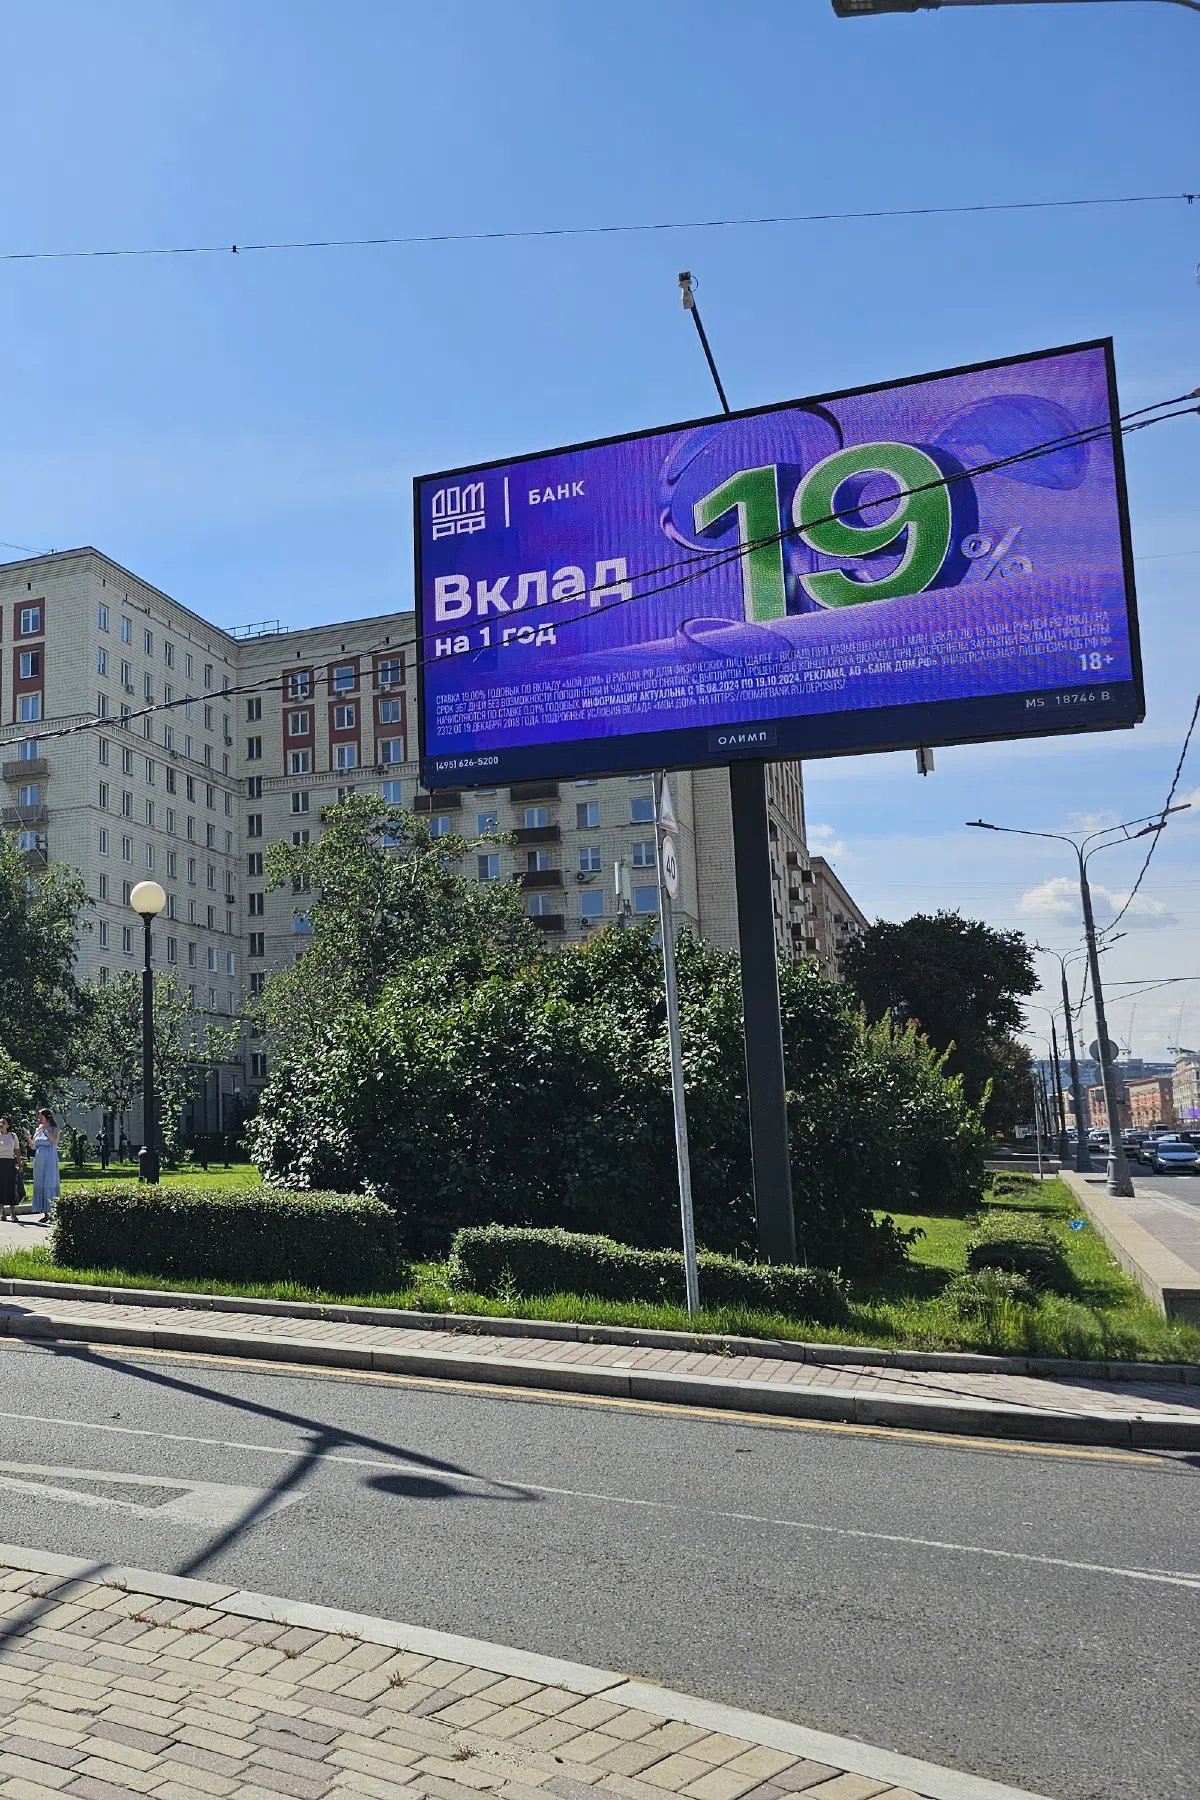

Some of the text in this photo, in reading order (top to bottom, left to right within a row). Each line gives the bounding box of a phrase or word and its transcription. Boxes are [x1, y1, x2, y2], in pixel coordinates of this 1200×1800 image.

[432, 481, 485, 517] ДОМ
[527, 479, 585, 506] БАНК
[434, 556, 633, 624] Вклад
[434, 622, 557, 657] на 1 год
[1078, 649, 1115, 671] 18+
[487, 708, 497, 719] ПО
[581, 691, 637, 708] ИНФОРМАЦИЯ
[639, 686, 685, 701] АКТУАЛЬНА
[740, 677, 753, 689] ПО
[848, 664, 861, 676] АО
[520, 683, 531, 694] ПО
[435, 703, 453, 715] СРОК
[487, 698, 499, 708] БЕЗ
[1025, 697, 1045, 708] MS
[1055, 692, 1096, 705] 18746
[471, 718, 502, 732] ДЕКАБРЯ
[502, 716, 520, 727] 2018
[717, 731, 767, 745] ОЛИМП
[435, 755, 499, 770] (495) 626-5200
[666, 855, 676, 880] 40
